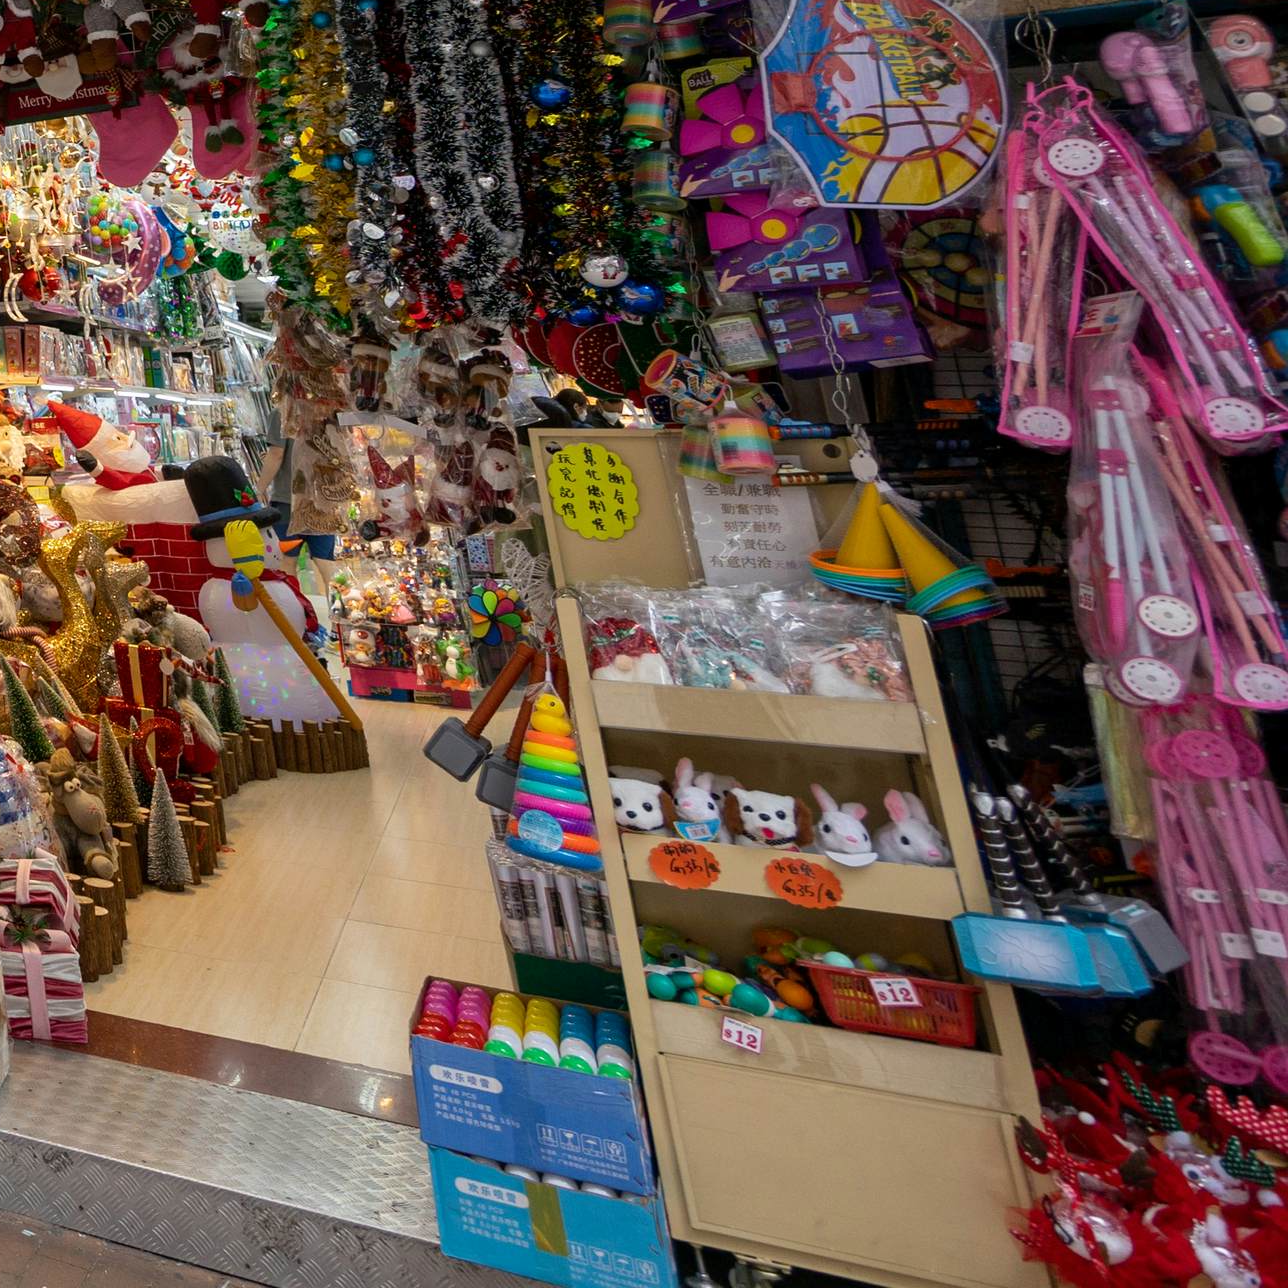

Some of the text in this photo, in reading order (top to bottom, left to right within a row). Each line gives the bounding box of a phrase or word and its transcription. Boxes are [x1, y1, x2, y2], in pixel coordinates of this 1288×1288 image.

[17, 92, 54, 110] Merry
[877, 987, 914, 1003] $12
[723, 1027, 758, 1050] $12
